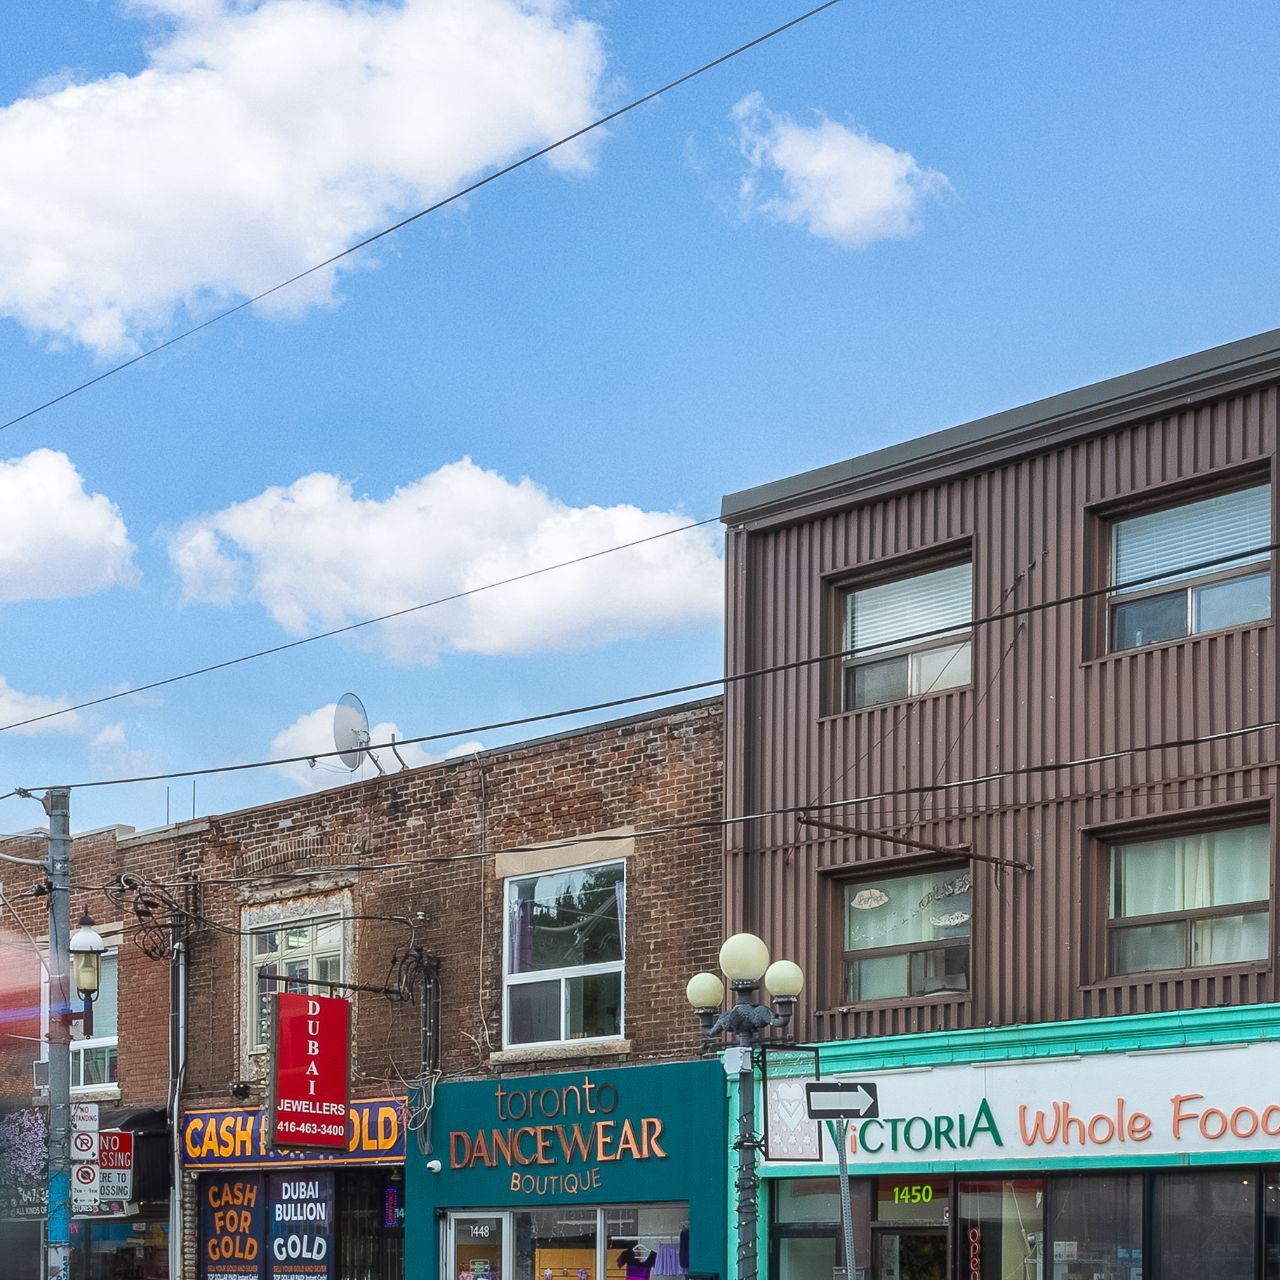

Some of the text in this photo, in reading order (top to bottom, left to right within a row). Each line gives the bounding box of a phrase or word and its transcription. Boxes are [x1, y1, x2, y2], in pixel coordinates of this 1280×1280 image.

[305, 1000, 320, 1095] DUBAI
[277, 1099, 345, 1116] JEWELLERS
[494, 1075, 618, 1120] toronto
[277, 1121, 344, 1136] 416-463-3400
[1019, 1097, 1152, 1146] Whole
[100, 1135, 120, 1150] NO
[185, 1115, 255, 1158] CASH
[449, 1117, 667, 1169] DANCEWEAR
[101, 1152, 131, 1167] SSING
[117, 1173, 126, 1183] TO
[510, 1167, 602, 1195] BOUTIQUE
[100, 1185, 128, 1196] OSSING
[208, 1182, 258, 1208] CASH
[282, 1181, 319, 1200] DUBAI
[893, 1185, 933, 1204] 1450
[213, 1209, 252, 1234] FOR
[275, 1202, 326, 1222] BULLION
[470, 1225, 490, 1238] 1448
[207, 1235, 258, 1261] GOLD
[273, 1234, 328, 1261] GOLD
